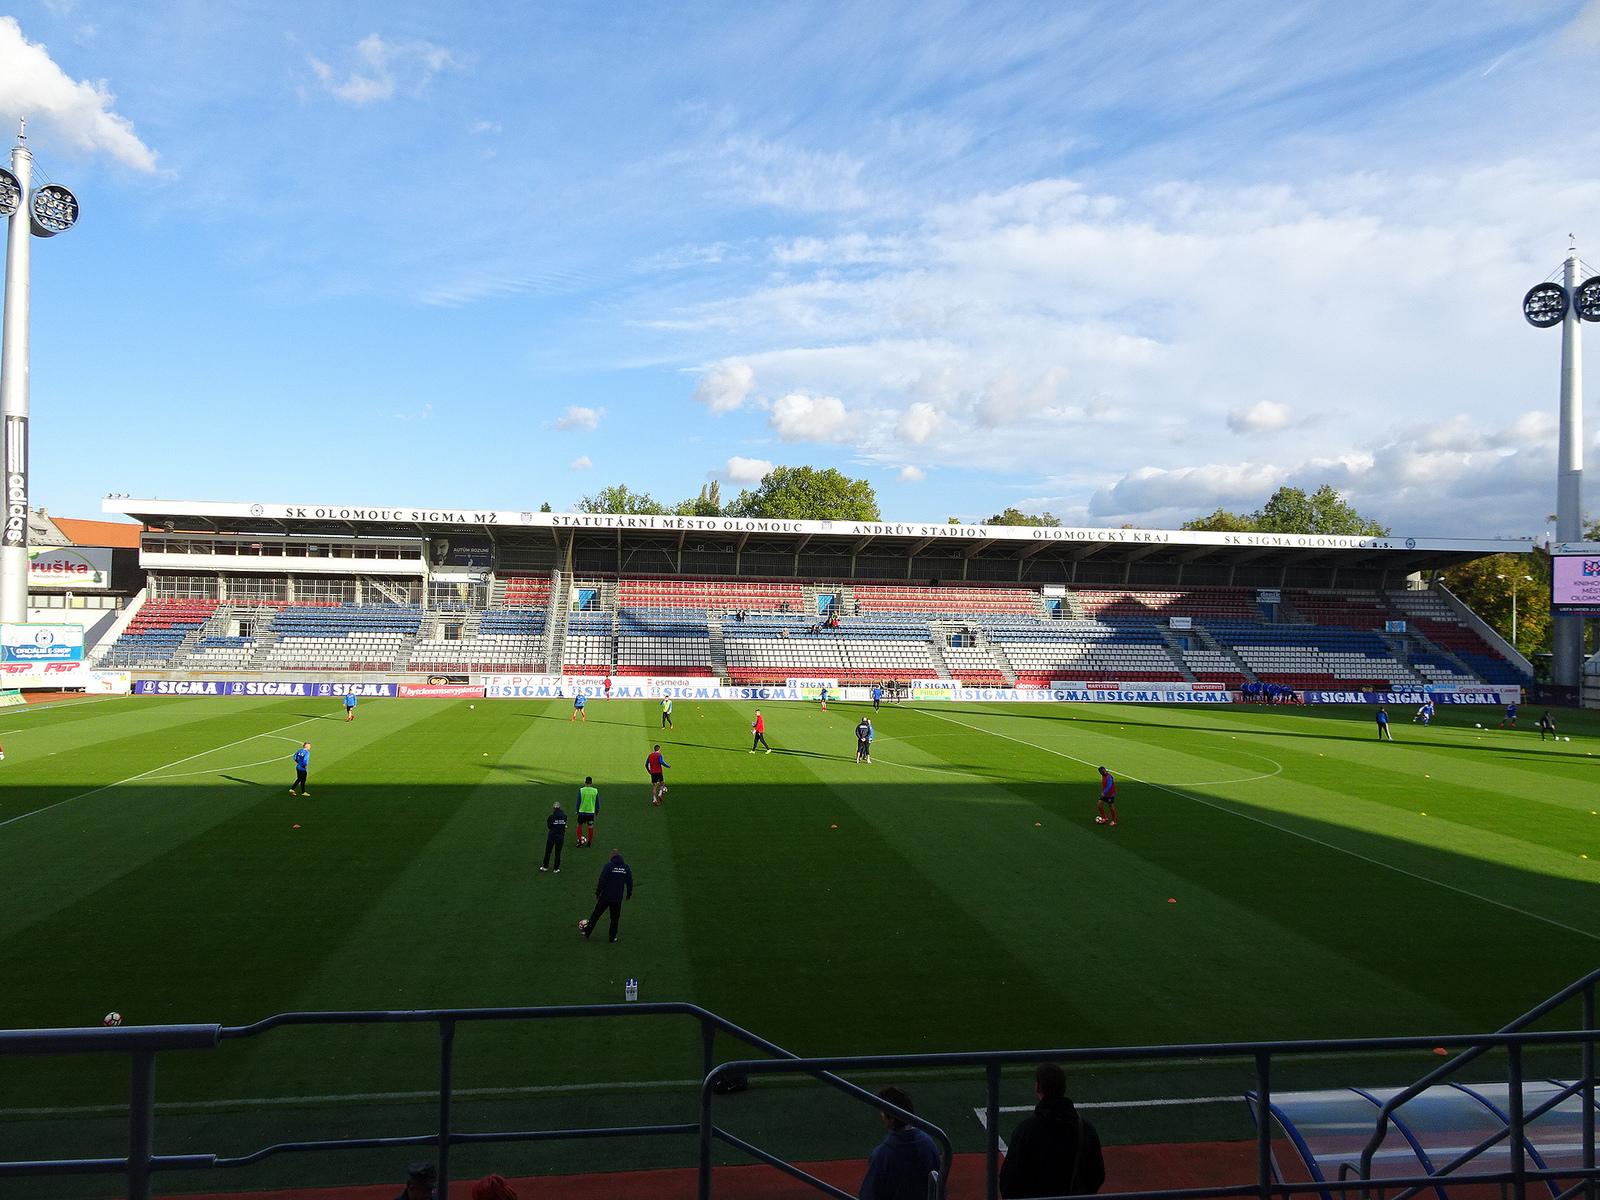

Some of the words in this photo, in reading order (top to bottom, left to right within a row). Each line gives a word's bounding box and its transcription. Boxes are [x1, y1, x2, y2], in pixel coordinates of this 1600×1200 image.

[7, 474, 27, 541] adidas
[286, 507, 306, 518] SK
[315, 508, 403, 521] OLOMOUC
[411, 511, 466, 523] SIGMA
[474, 511, 498, 524] MŽ
[552, 515, 655, 528] STATUTÁRNÍ
[662, 517, 717, 530] MĚSTO
[723, 520, 803, 533] OLOMOUC
[852, 523, 915, 536] ANDRŮV
[921, 526, 988, 538] STADION
[1032, 529, 1126, 542] OLOMOUCKÝ
[1133, 532, 1169, 543] KRAJ
[1224, 535, 1241, 545] SK
[1247, 535, 1293, 547] SIGMA
[1298, 537, 1366, 548] OLOMOUC
[1372, 540, 1393, 549] a.s.
[655, 678, 690, 686] esmedia
[158, 681, 217, 695] SIGMA
[246, 682, 305, 695] SIGMA
[332, 683, 390, 696] SIGMA
[503, 686, 562, 697] SIGMA
[662, 687, 722, 698] SIGMA
[741, 688, 799, 699] SIGMA
[964, 690, 1020, 700] SIGMA
[1037, 690, 1091, 701] SIGMA
[1107, 691, 1161, 701] SIGMA
[1177, 691, 1230, 702] SIGMA
[1321, 692, 1367, 703] SIGMA
[1387, 693, 1432, 704] SIGMA
[1452, 693, 1497, 704] SIGMA
